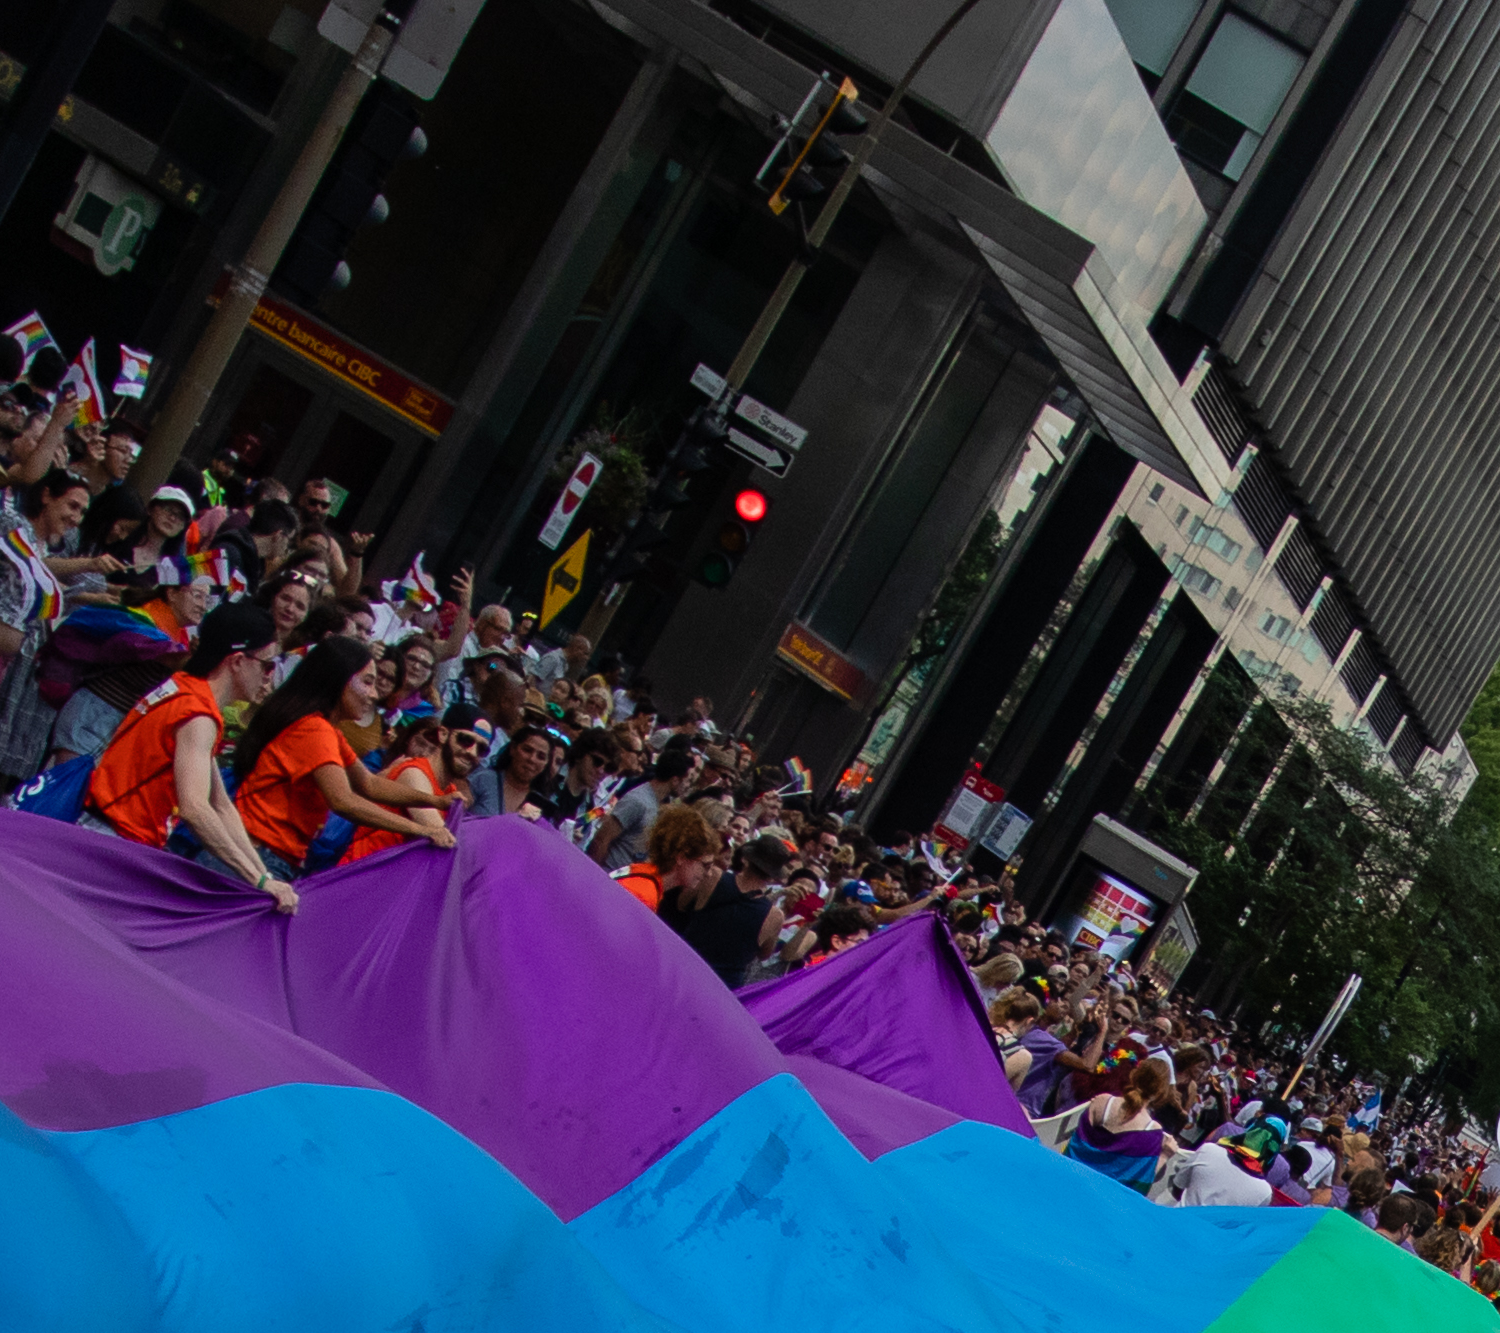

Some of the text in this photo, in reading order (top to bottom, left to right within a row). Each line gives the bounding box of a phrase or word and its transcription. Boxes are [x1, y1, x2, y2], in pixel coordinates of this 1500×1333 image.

[288, 320, 346, 367] bancaire
[348, 358, 382, 388] CIBC
[757, 414, 798, 443] Stanley
[1080, 930, 1103, 948] CIBC
